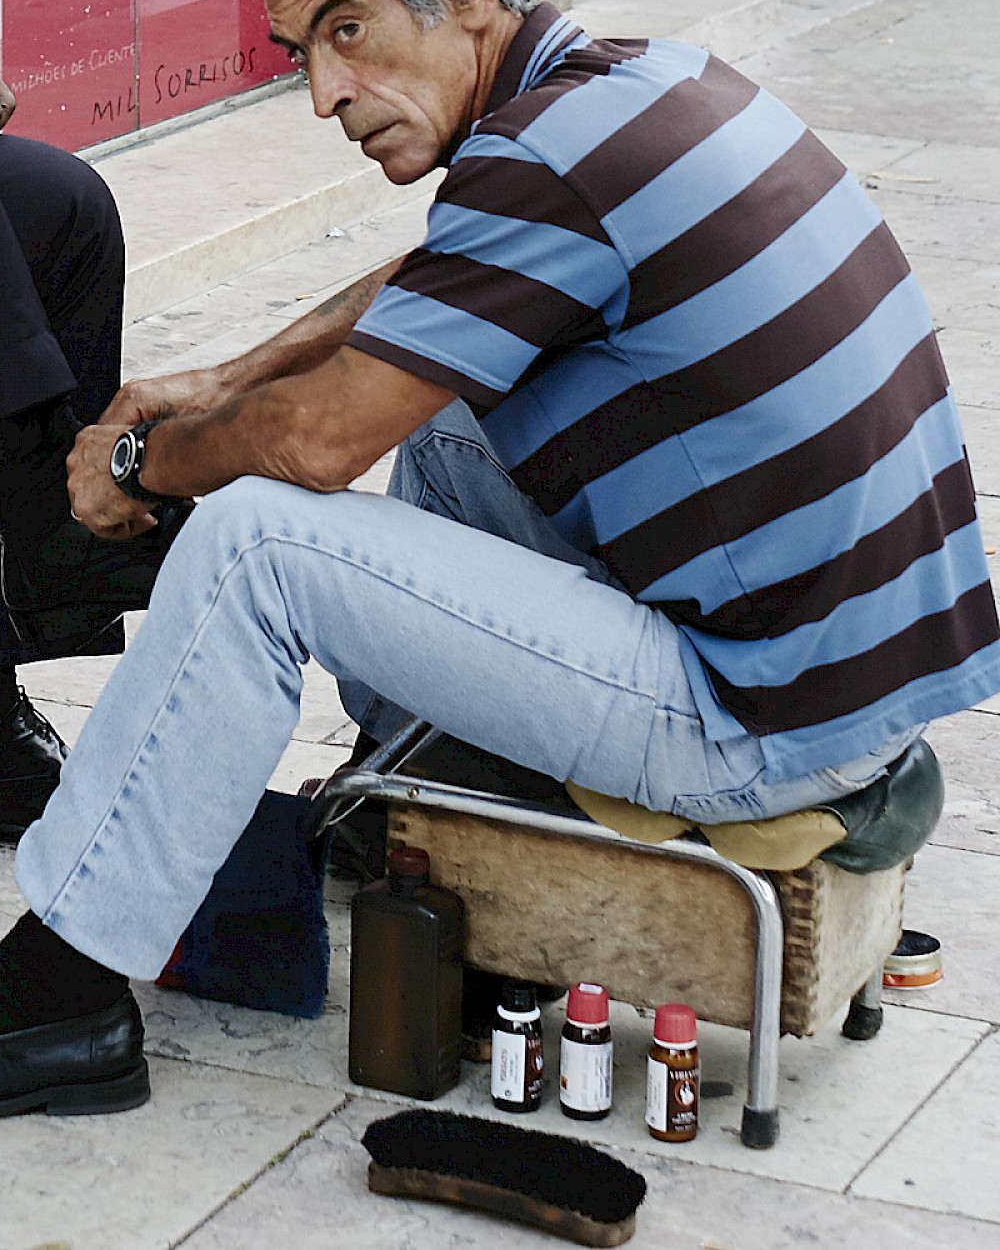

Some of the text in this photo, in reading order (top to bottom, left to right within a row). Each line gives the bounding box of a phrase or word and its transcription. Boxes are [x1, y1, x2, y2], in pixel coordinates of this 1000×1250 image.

[11, 60, 66, 93] MILHÕES
[70, 58, 86, 76] DE
[90, 47, 257, 125] MIL SORRISOS
